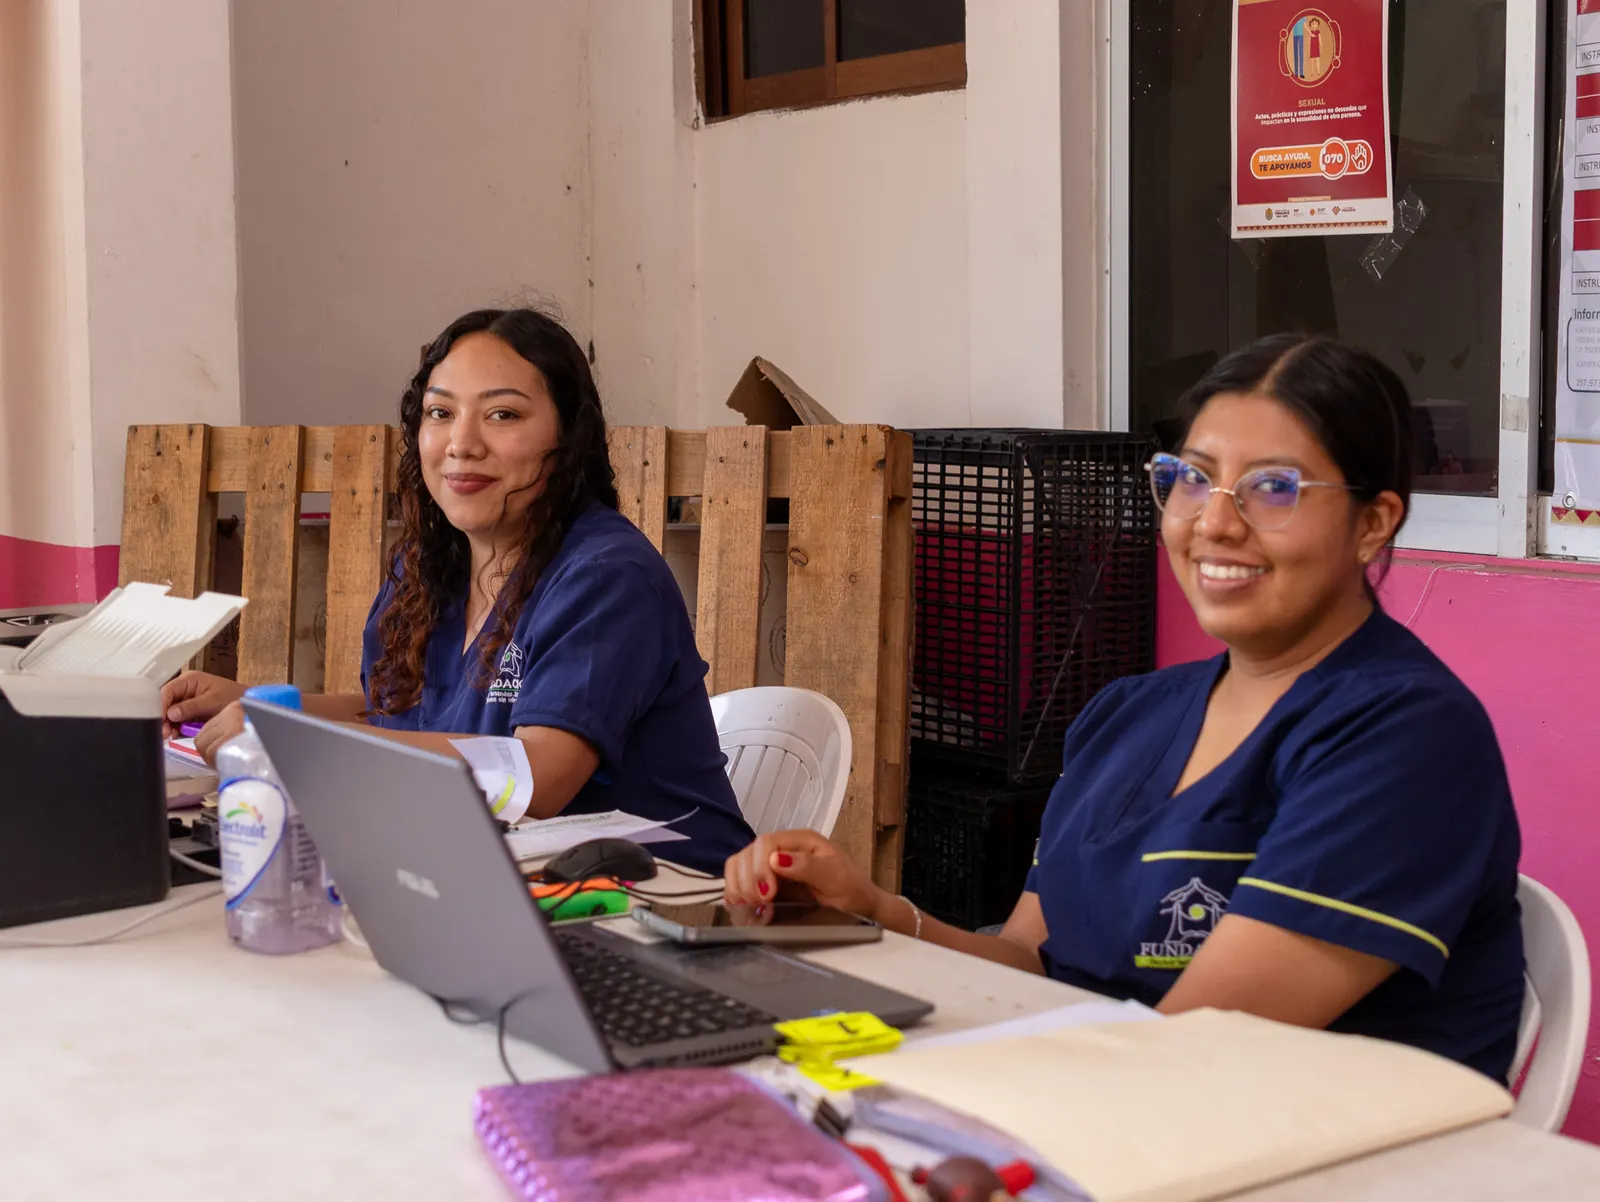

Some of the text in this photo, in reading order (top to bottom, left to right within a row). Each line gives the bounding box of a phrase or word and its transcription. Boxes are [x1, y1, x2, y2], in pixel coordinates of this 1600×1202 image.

[1298, 97, 1326, 107] SEXUAL
[1255, 113, 1270, 121] Actos,
[1271, 111, 1293, 119] prácticas
[1298, 109, 1327, 117] expresiones
[1334, 105, 1357, 113] deseadas
[1261, 118, 1283, 126] impactan
[1296, 114, 1322, 122] sexualidad
[1587, 124, 1600, 135] INS
[1258, 152, 1311, 163] BUSCA AYUDA,
[1324, 153, 1343, 164] 070
[1259, 161, 1312, 172] TE APOYAMOS
[1140, 942, 1200, 957] FUND
